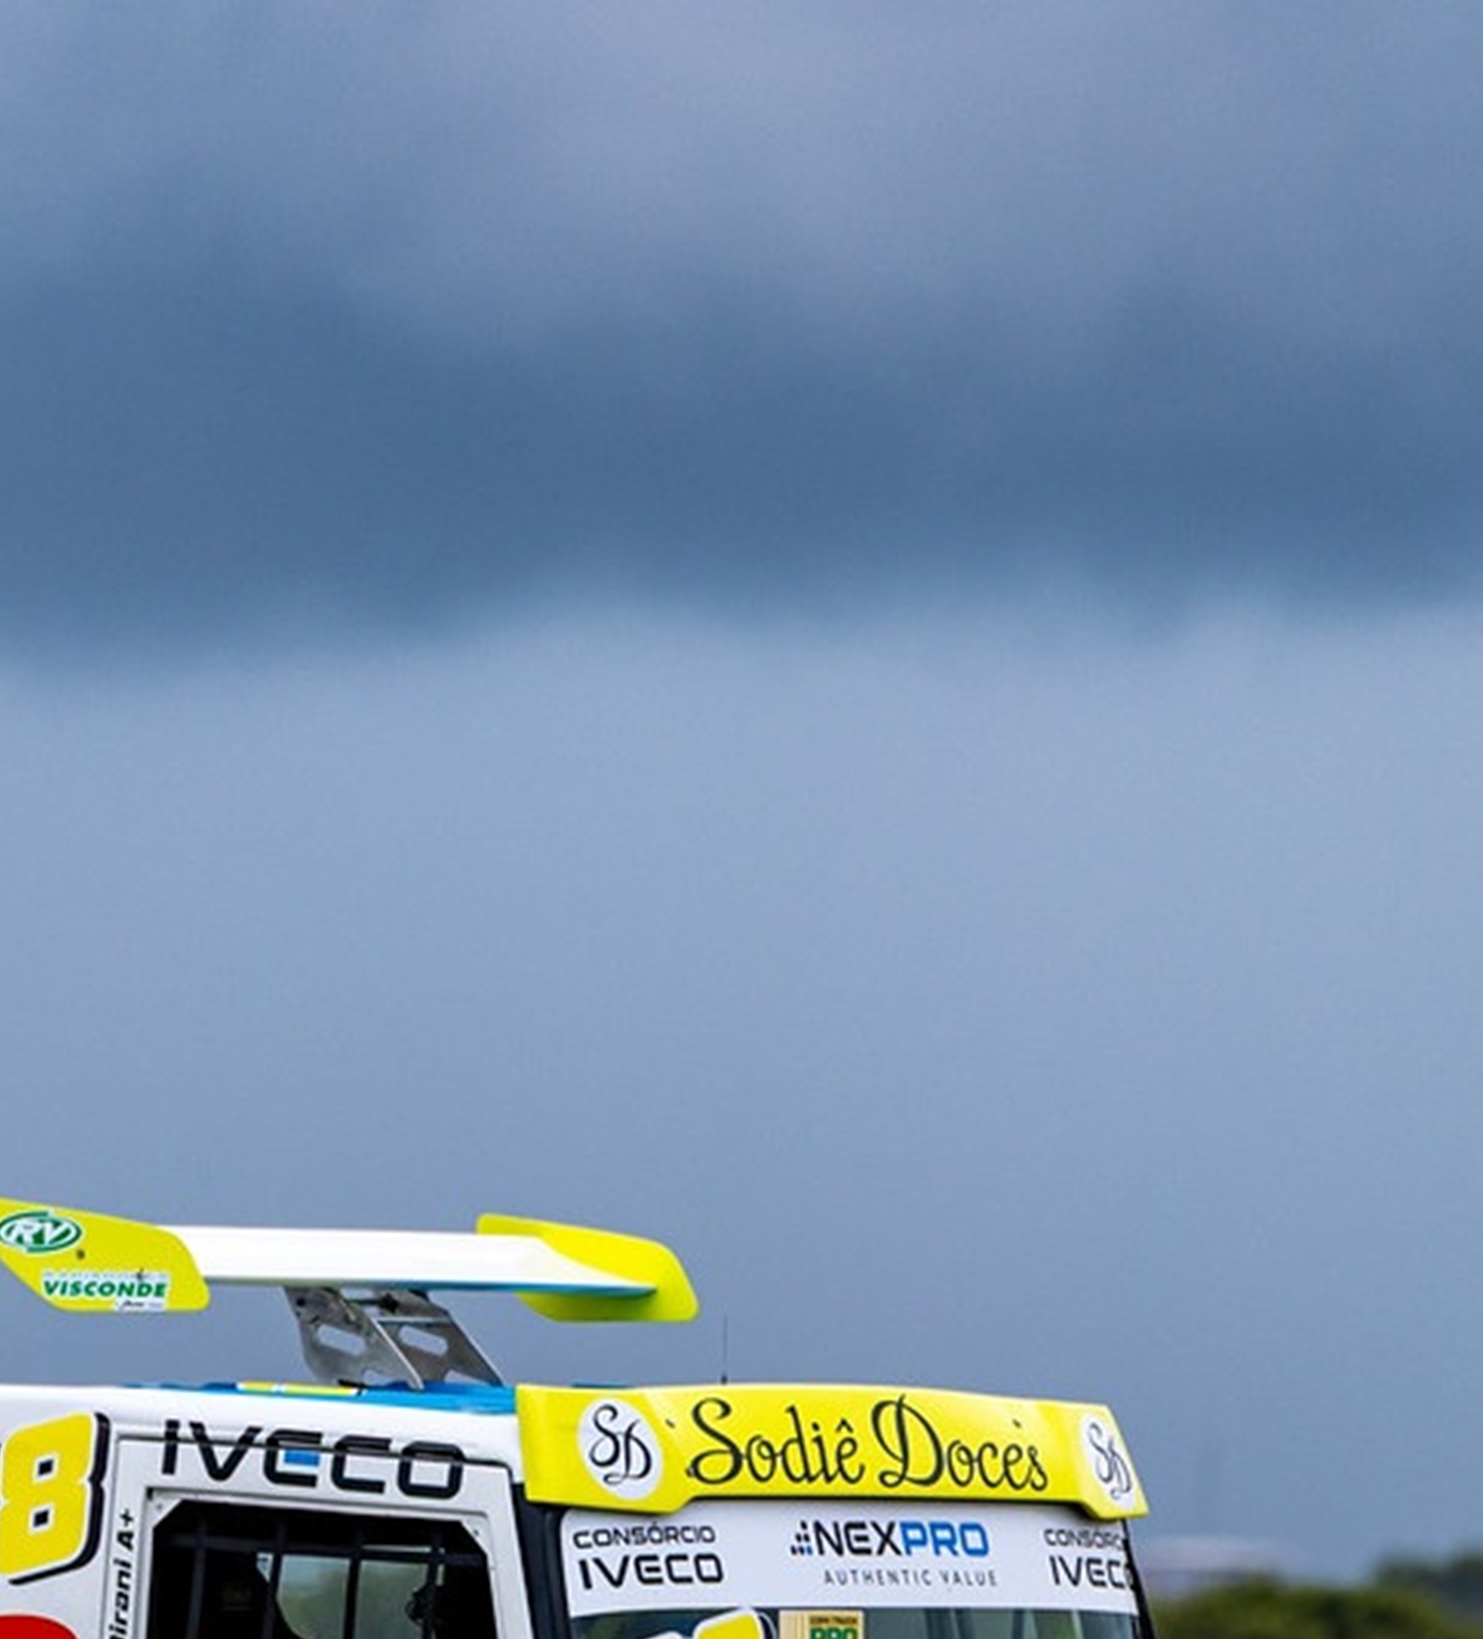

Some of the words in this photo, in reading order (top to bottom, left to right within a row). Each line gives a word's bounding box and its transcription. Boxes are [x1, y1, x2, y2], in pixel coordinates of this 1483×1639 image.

[6, 1218, 71, 1246] RV
[44, 1280, 166, 1297] VISCONDE
[162, 1419, 465, 1500] IVECO
[588, 1404, 652, 1486] SD
[685, 1397, 865, 1485] Sodiê
[871, 1394, 1048, 1491] Doces
[117, 1508, 135, 1550] A+
[573, 1521, 716, 1549] CONSÓRCIO
[813, 1521, 991, 1557] NEXPRO
[578, 1553, 724, 1590] IVECO
[824, 1569, 932, 1587] AUTHENTIC
[941, 1570, 998, 1587] VALUE
